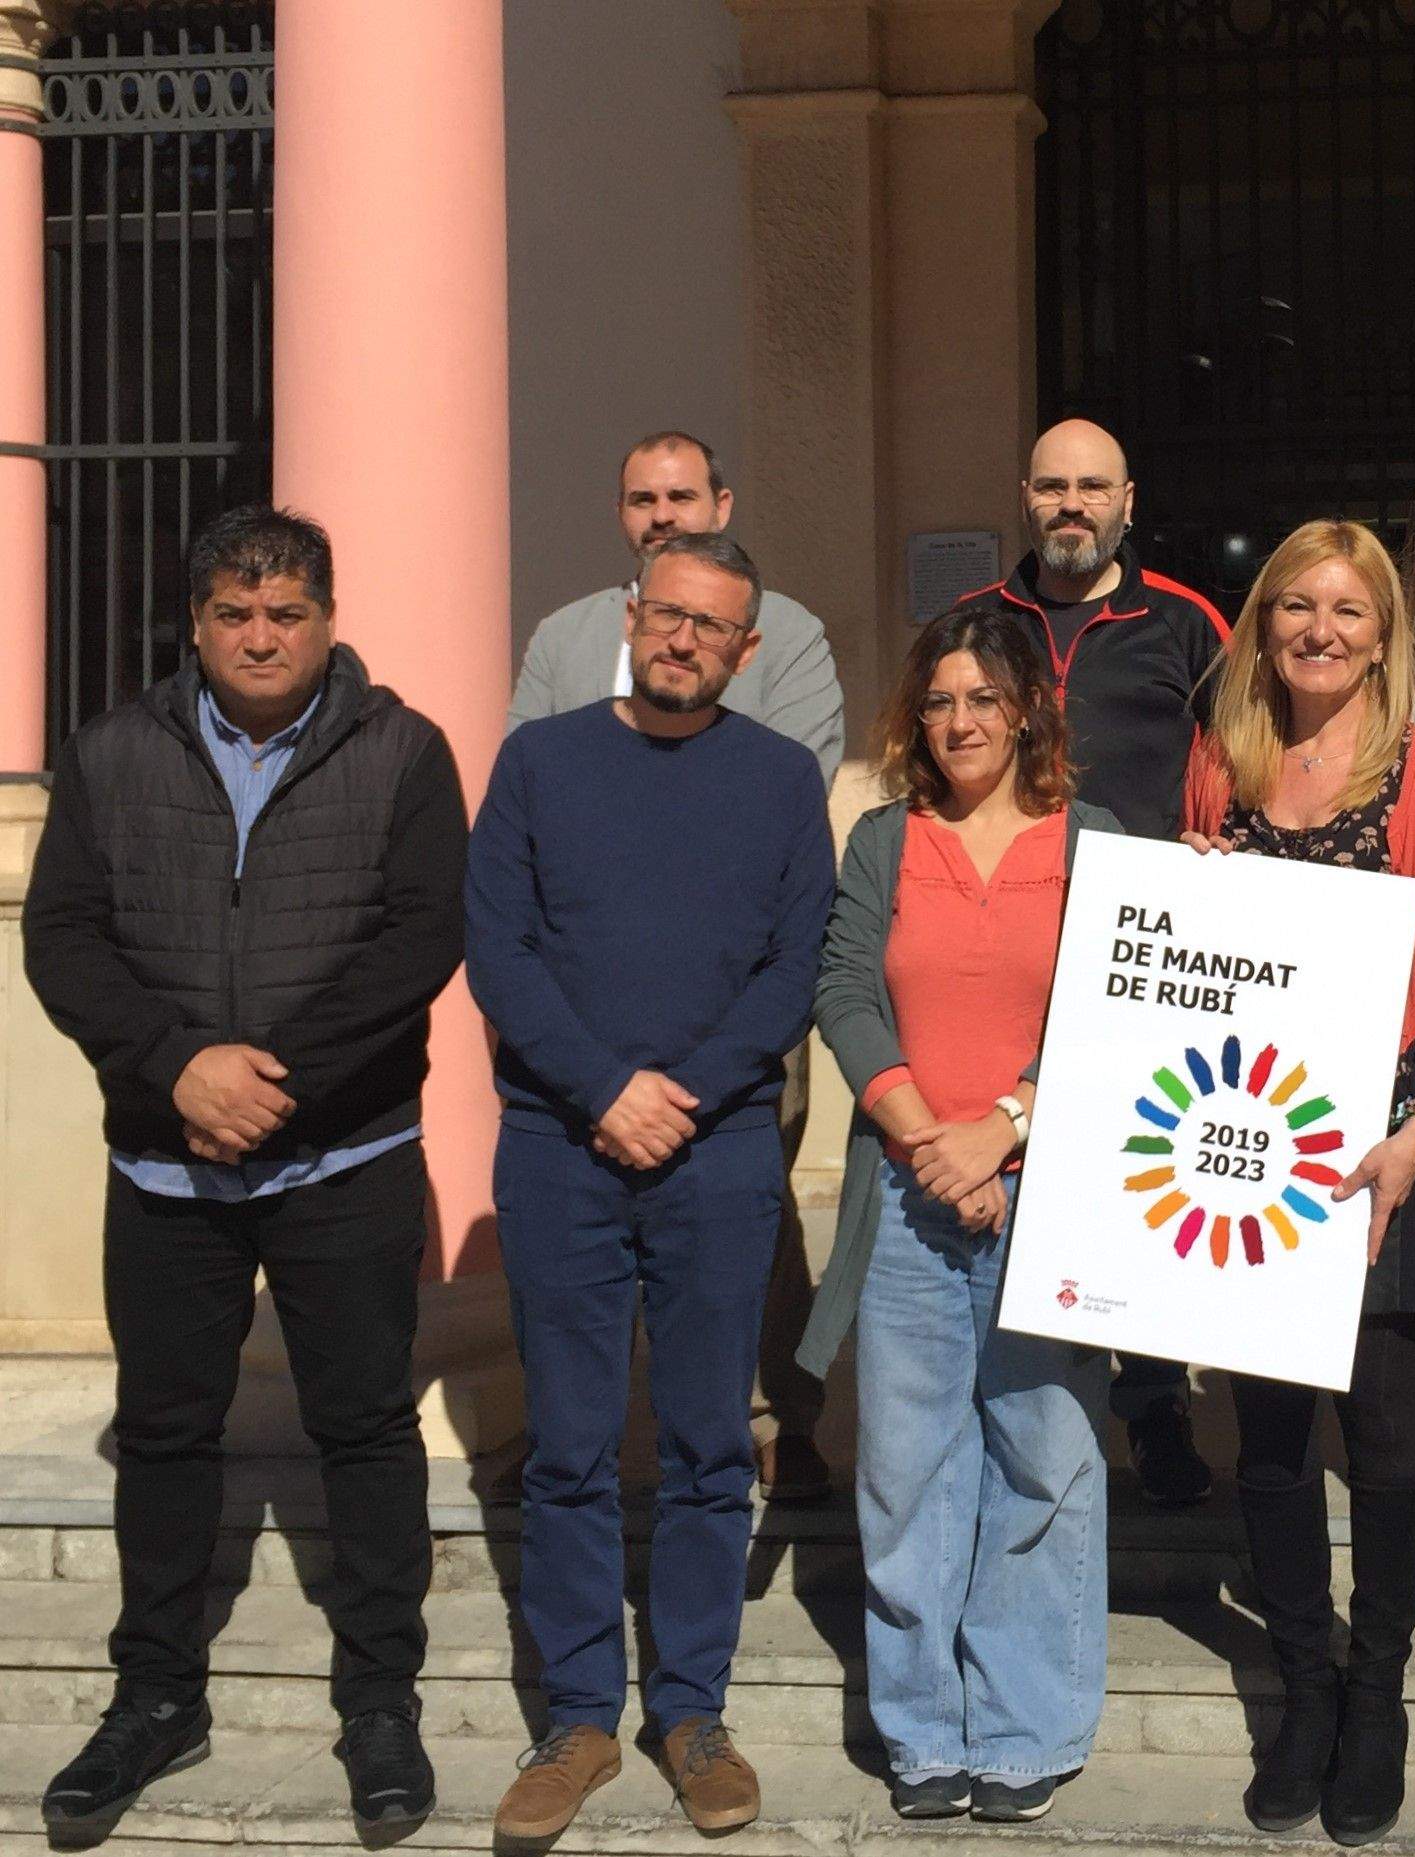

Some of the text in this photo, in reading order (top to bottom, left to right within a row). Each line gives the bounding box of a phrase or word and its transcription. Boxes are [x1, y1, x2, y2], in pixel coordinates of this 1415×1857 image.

[1118, 905, 1173, 936] PLA
[1111, 938, 1298, 989] DE MANDAT
[1106, 972, 1237, 1016] DE RUBÍ
[1199, 1121, 1270, 1153] 2019
[1195, 1150, 1265, 1182] 2023
